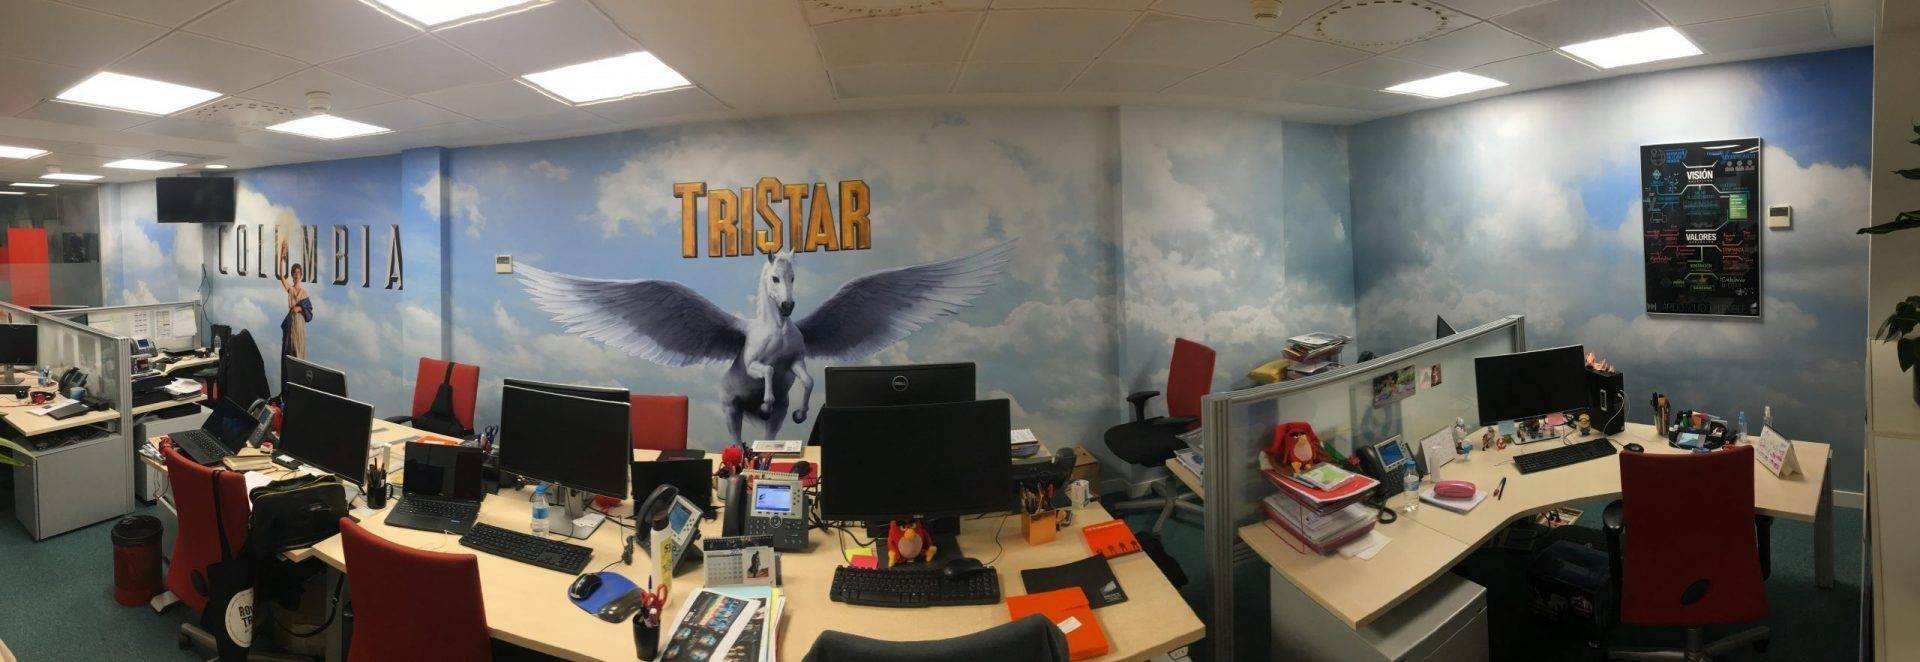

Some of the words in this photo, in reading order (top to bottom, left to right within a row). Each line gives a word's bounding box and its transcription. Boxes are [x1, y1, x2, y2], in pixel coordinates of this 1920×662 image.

[1686, 169, 1713, 180] VISIÓN
[1685, 233, 1717, 241] VALORES
[218, 224, 404, 290] COLUMBIA
